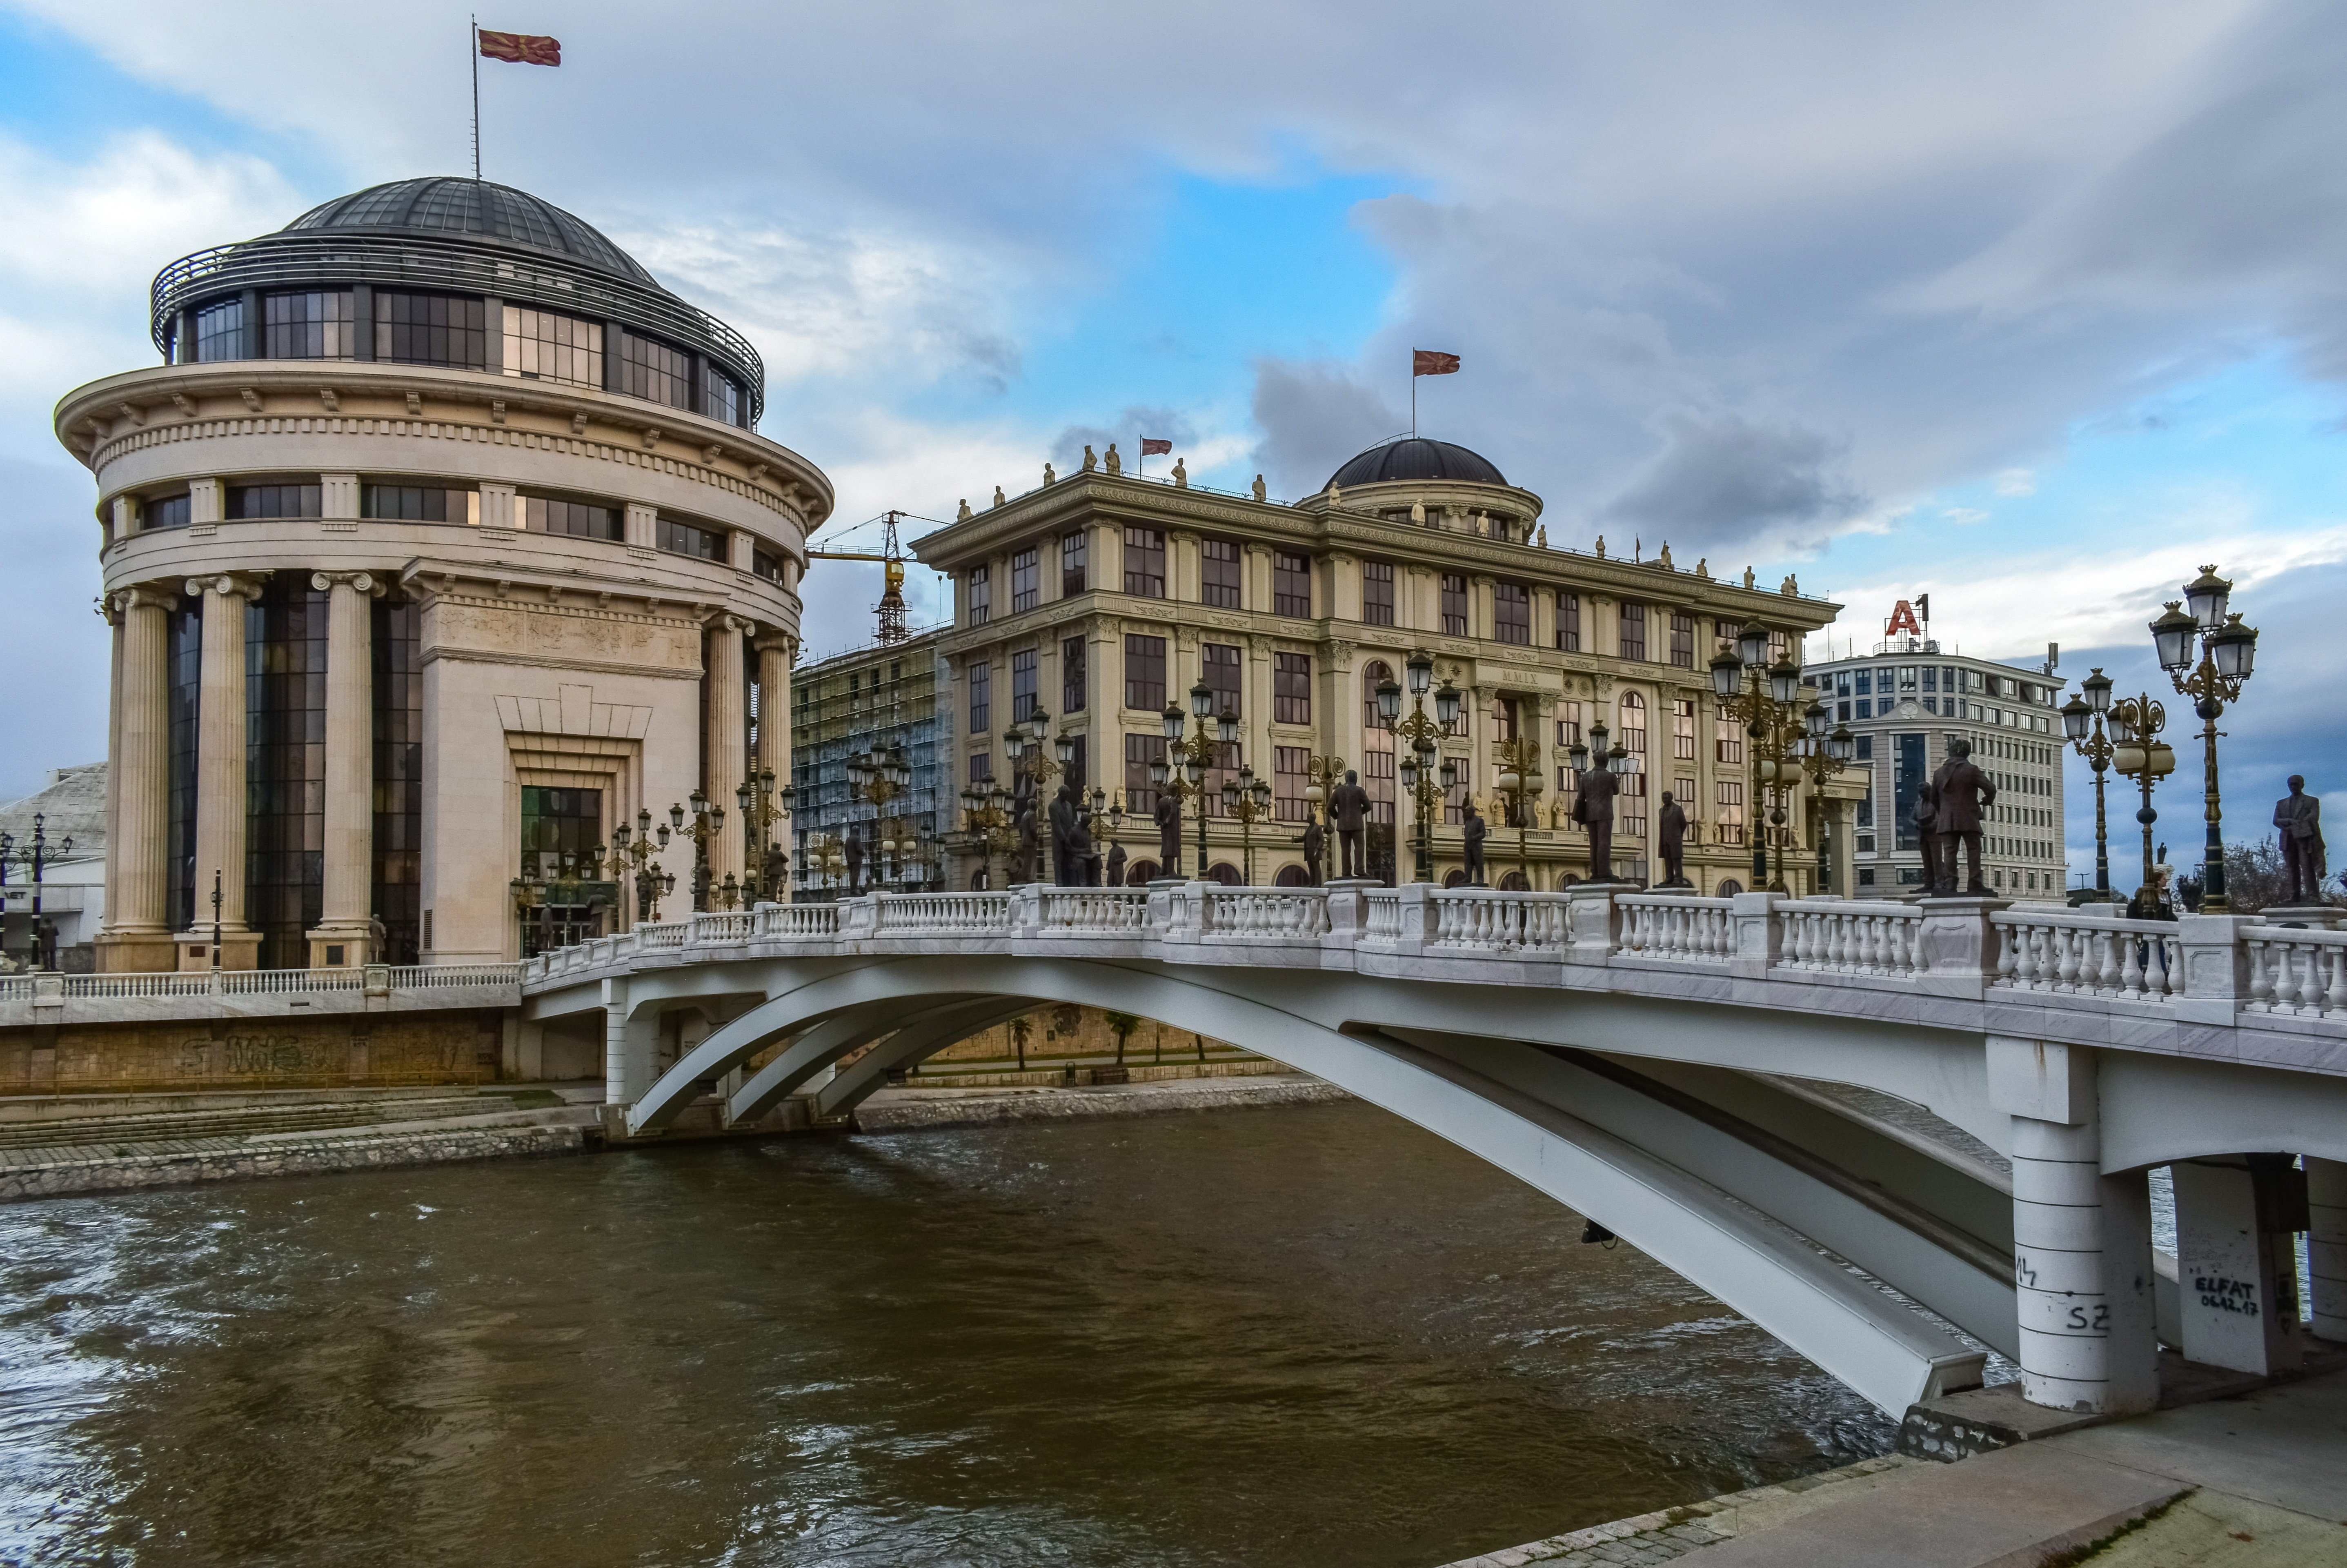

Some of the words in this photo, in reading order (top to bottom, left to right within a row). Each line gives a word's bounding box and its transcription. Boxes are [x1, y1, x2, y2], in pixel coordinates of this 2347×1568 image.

[1885, 593, 1929, 636] A1
[1502, 670, 1538, 684] MMIX
[2195, 1277, 2254, 1299] ELFAT
